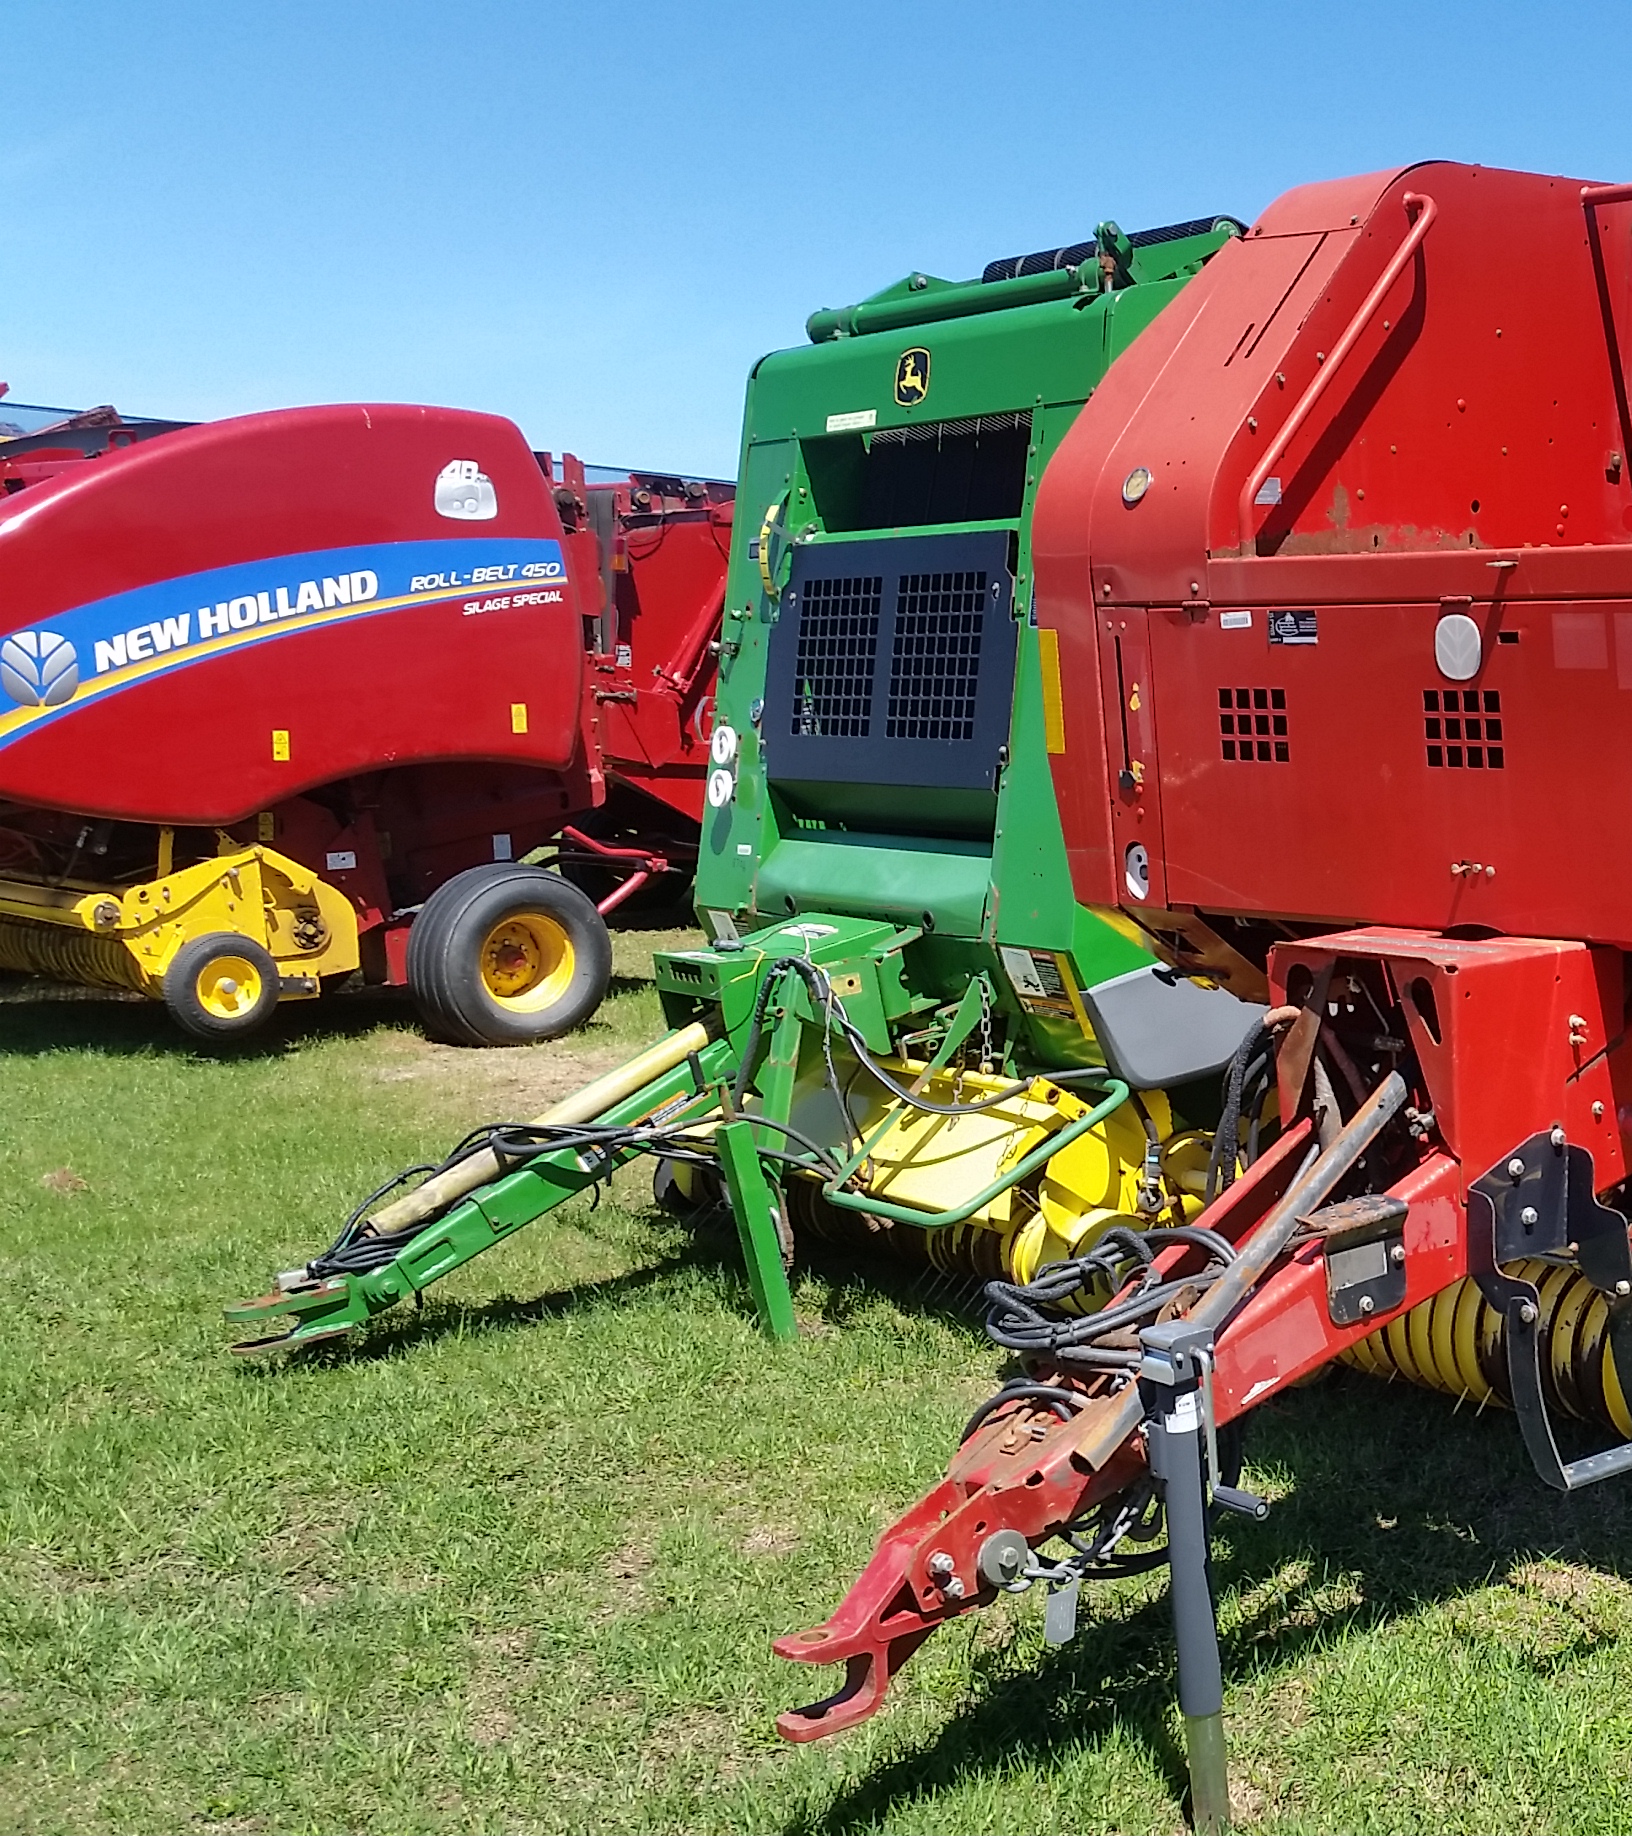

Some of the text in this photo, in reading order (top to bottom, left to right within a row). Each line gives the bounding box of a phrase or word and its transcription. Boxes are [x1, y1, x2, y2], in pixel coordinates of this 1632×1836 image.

[410, 562, 561, 592] ROLL-BELT 450
[462, 590, 564, 616] SILAGE SPECIAL
[93, 569, 379, 673] NEW HOLLAND
